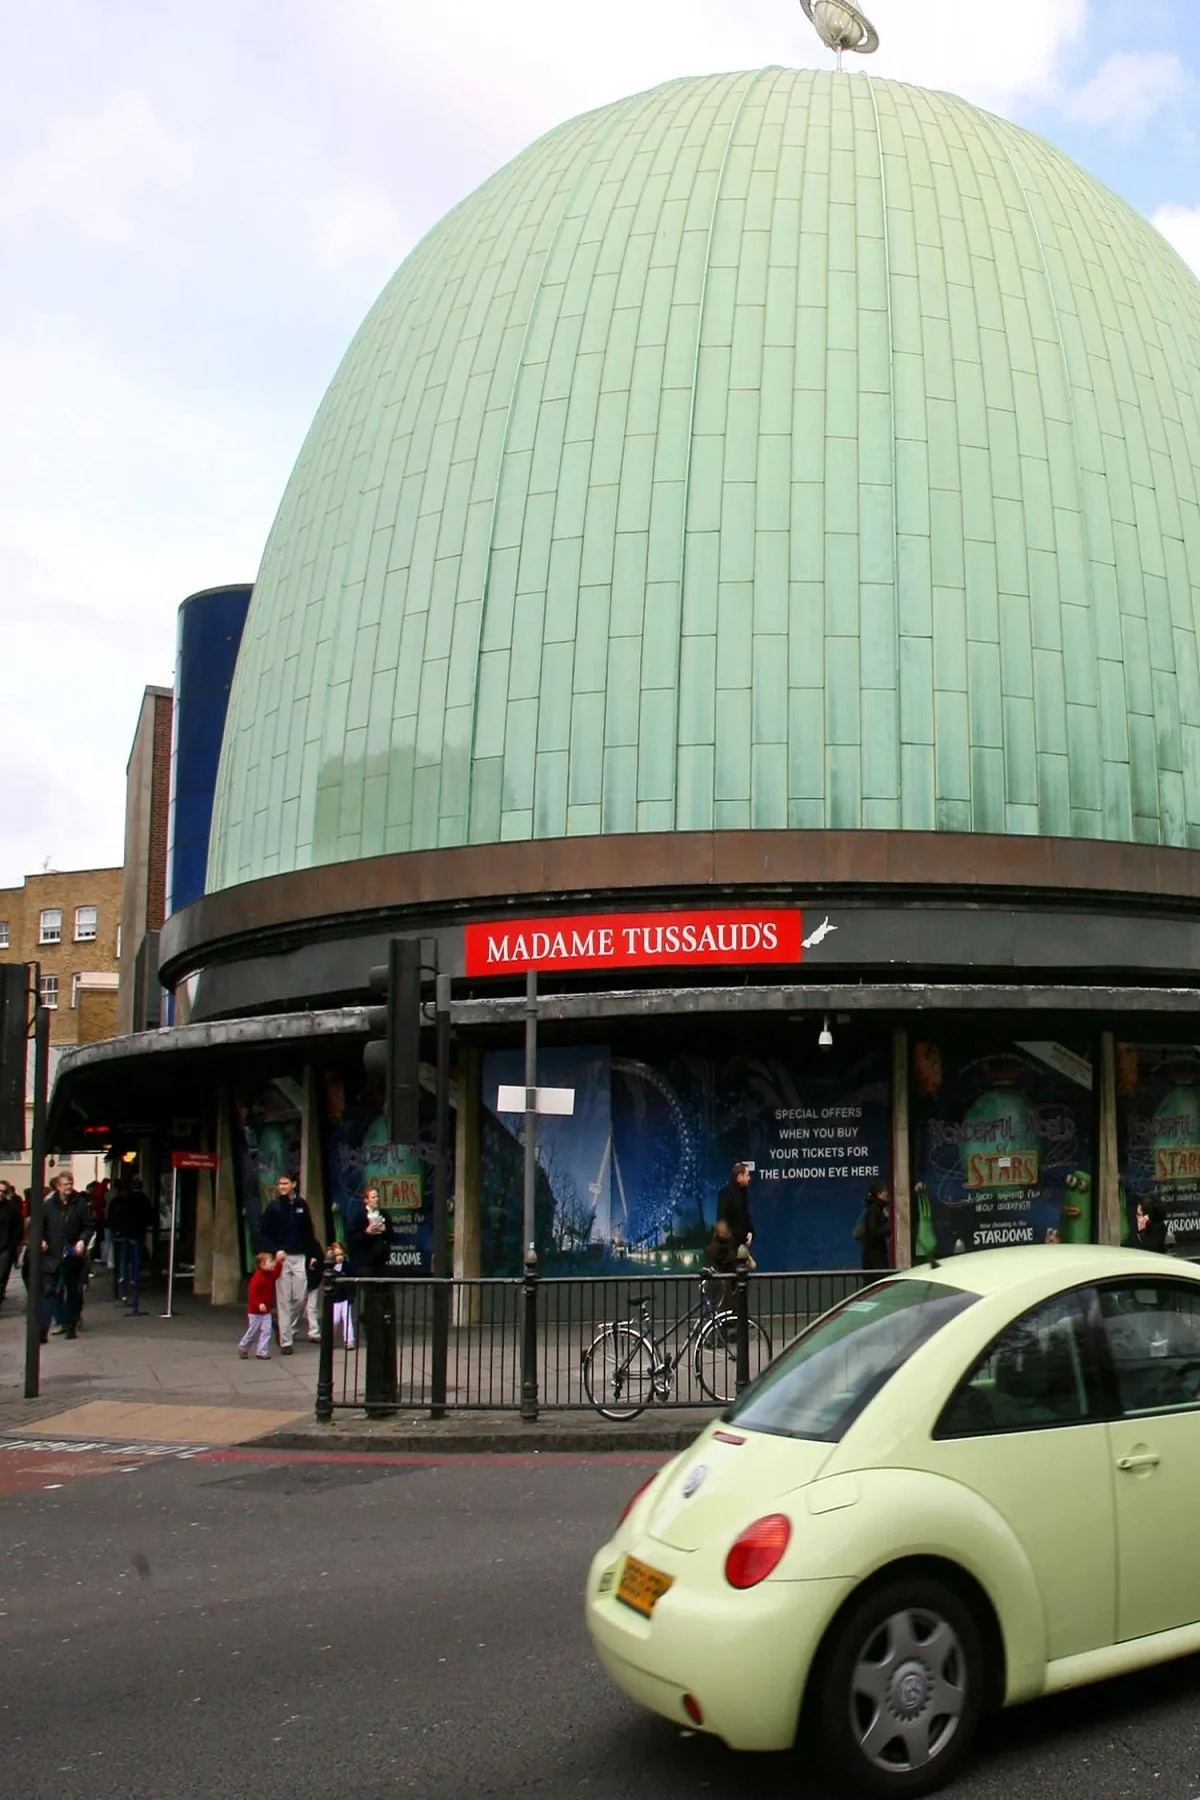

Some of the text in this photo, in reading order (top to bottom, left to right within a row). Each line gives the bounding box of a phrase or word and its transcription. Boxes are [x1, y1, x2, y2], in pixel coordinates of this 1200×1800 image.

[487, 922, 778, 963] MADAME TUSSAUD'S
[775, 1107, 862, 1120] SPECIAL OFFERS
[779, 1127, 859, 1139] WHEN YOU BUY
[769, 1146, 869, 1159] YOUR TICKETS FOR
[759, 1165, 879, 1180] THE LONDON EYE HERE
[963, 1152, 1038, 1190] STARS
[973, 1228, 1034, 1245] STARDOME
